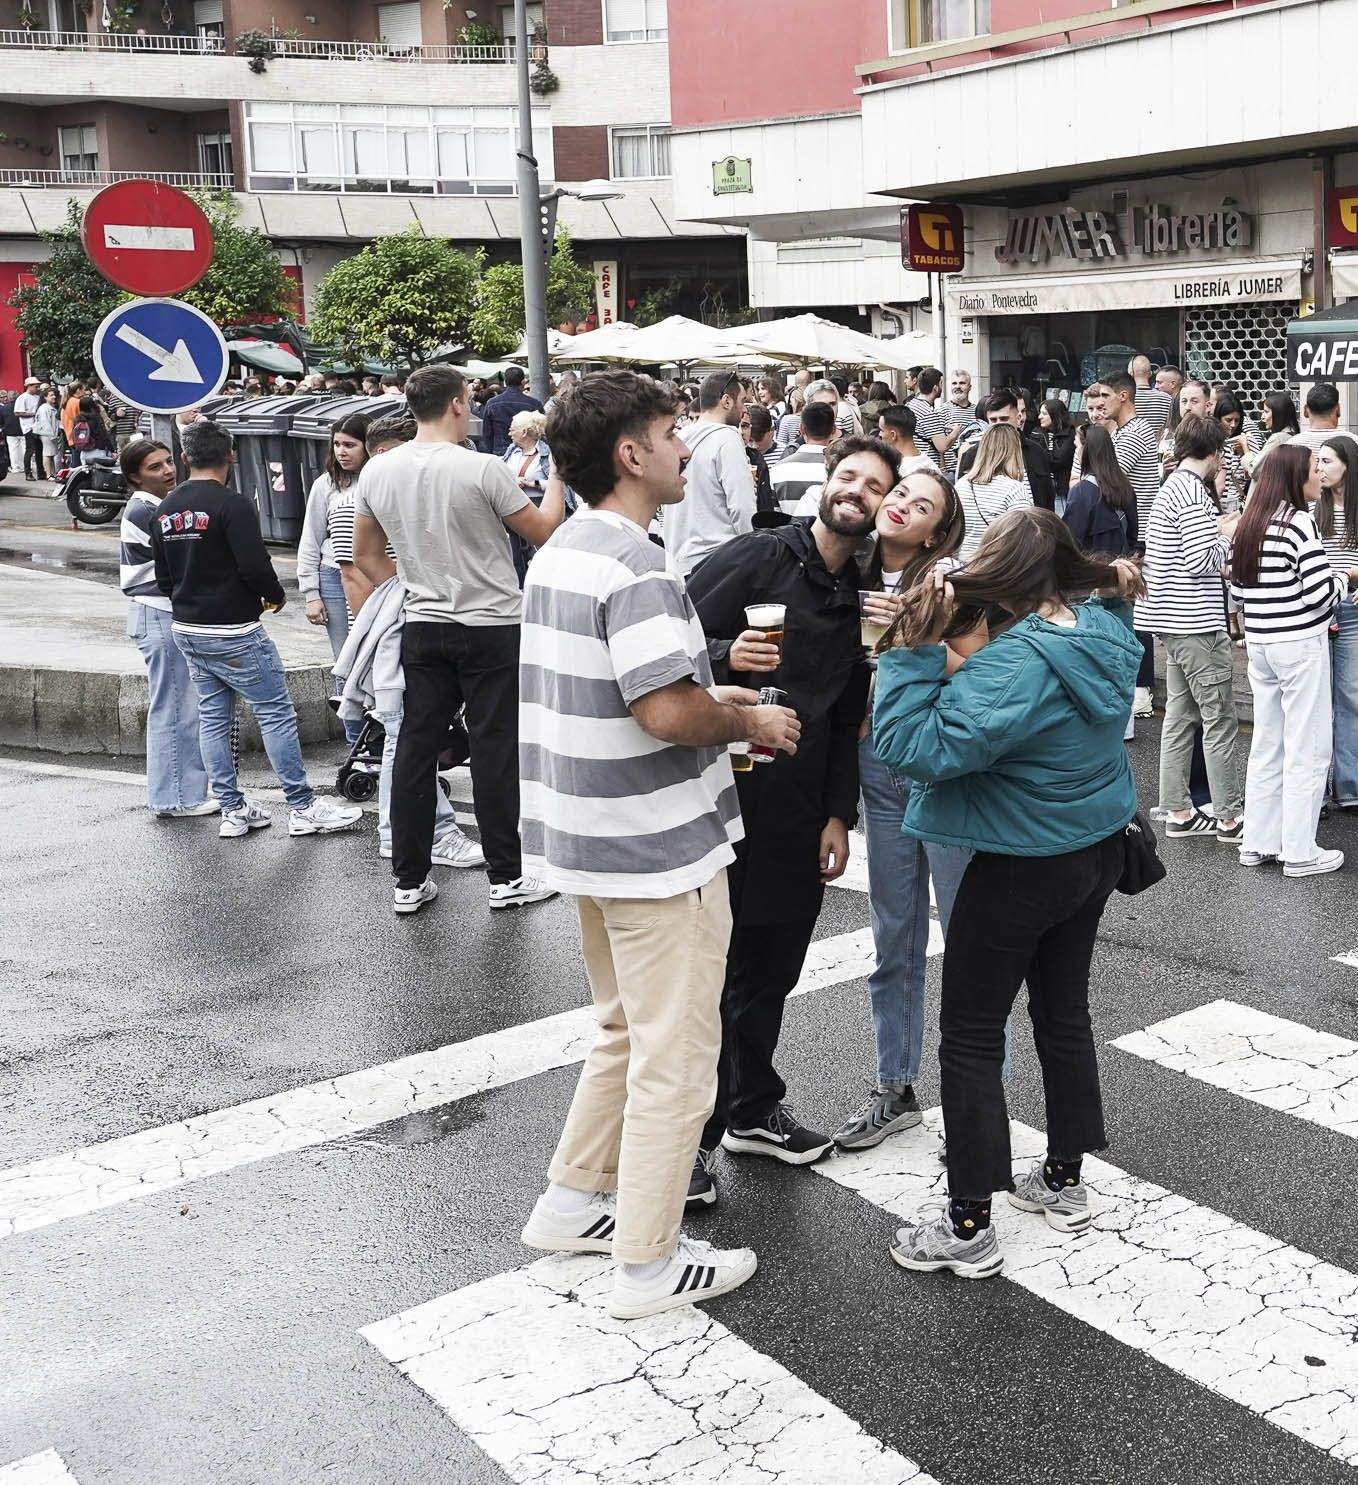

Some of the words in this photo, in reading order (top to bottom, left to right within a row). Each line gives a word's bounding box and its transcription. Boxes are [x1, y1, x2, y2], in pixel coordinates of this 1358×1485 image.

[994, 210, 1117, 263] JUMER
[913, 254, 961, 266] TABACOS
[1174, 278, 1231, 299] LIBRERÍA
[1237, 277, 1283, 296] JUMER
[959, 294, 984, 310] Diario
[992, 290, 1038, 309] Pontevedra
